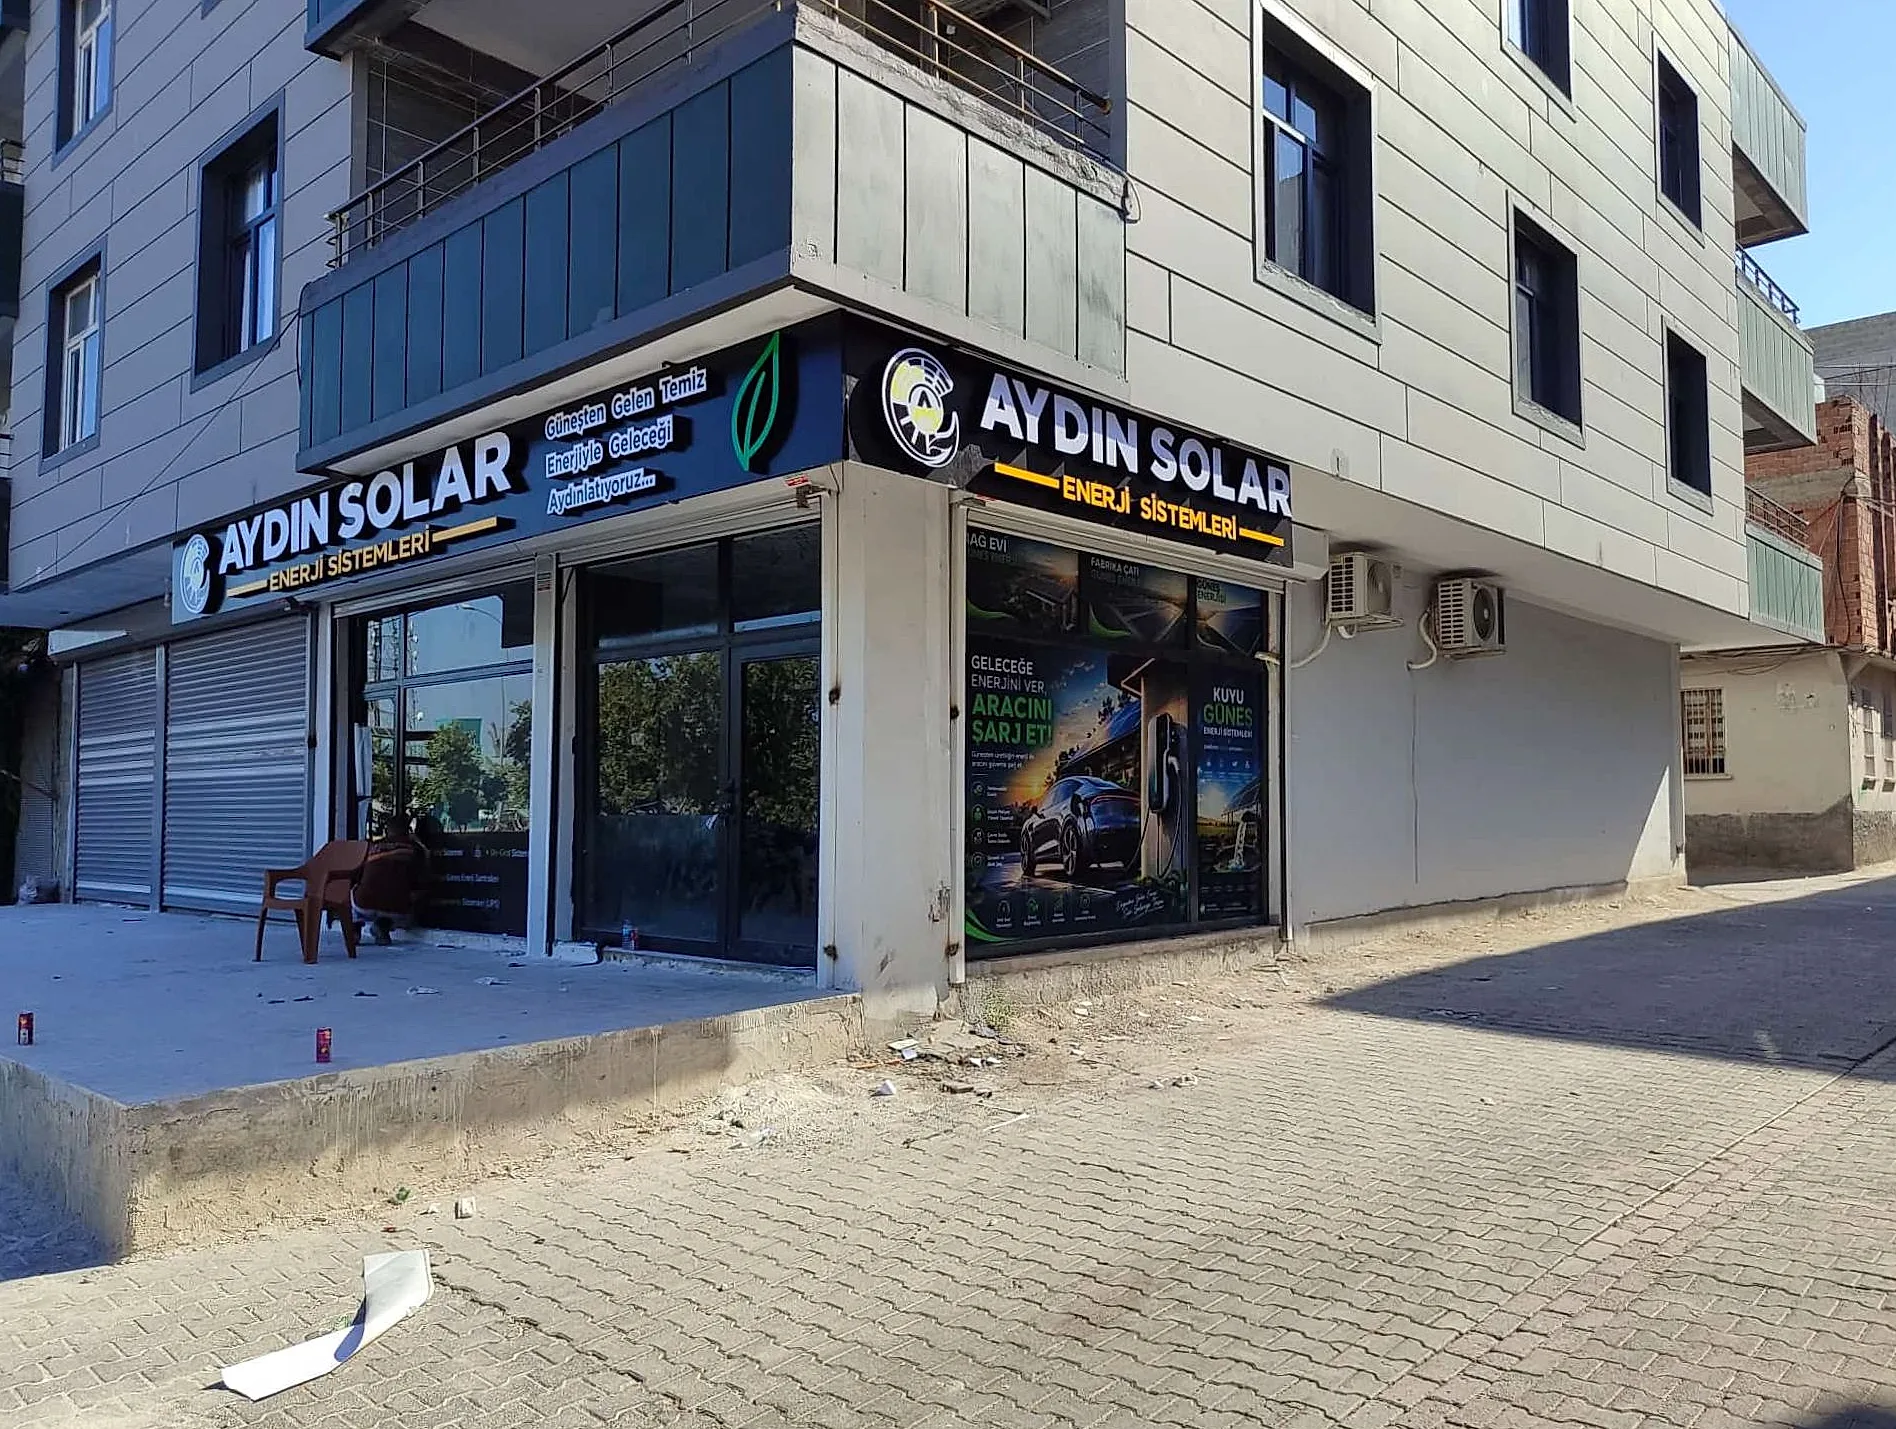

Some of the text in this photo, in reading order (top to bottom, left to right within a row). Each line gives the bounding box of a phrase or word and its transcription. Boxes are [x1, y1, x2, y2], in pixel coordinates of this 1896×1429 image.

[545, 365, 707, 440] Güneşten Gelen Temiz
[545, 414, 673, 478] Enerjiyle Geleceği
[980, 373, 1293, 518] AYDIN SOLAR
[219, 431, 512, 575] AYDIN SOLAR
[547, 467, 656, 515] Aydınlatıyoruz...
[1062, 475, 1237, 541] ENERJİ SİSTEMLERİ
[269, 524, 430, 592] ENERJİ SİSTEMLERİ
[967, 531, 987, 548] AĞ
[971, 655, 1034, 675] GELECEĞE
[971, 674, 1021, 691] ENERJİNİ
[972, 693, 1052, 721] ARACINI
[1213, 686, 1244, 705] KUYU
[972, 720, 1052, 746] ŞARJ ET!
